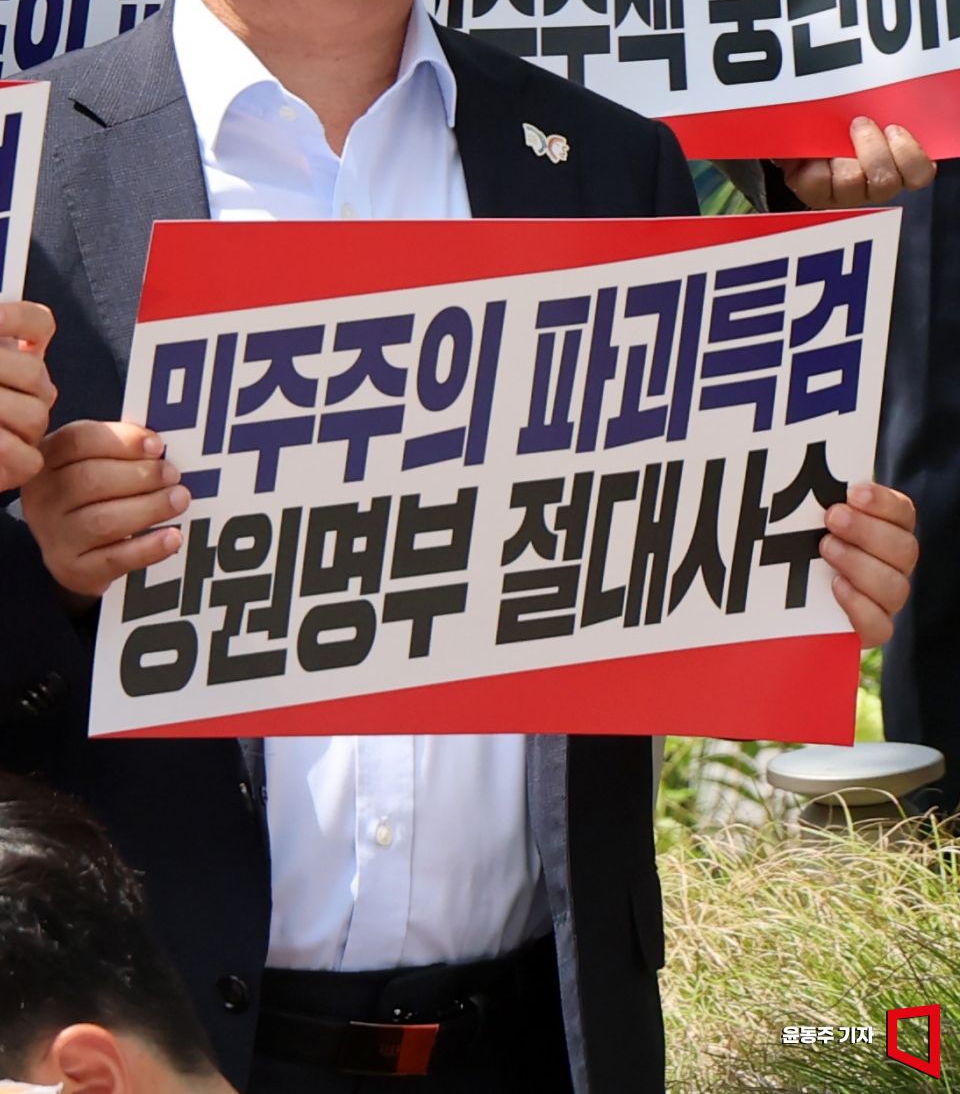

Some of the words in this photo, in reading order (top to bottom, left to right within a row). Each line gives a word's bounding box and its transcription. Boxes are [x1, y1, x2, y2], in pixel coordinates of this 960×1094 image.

[145, 300, 507, 499] 민주주의
[516, 239, 874, 457] 파괴특검
[118, 486, 479, 698] 당원명부
[495, 440, 849, 645] 절대사수
